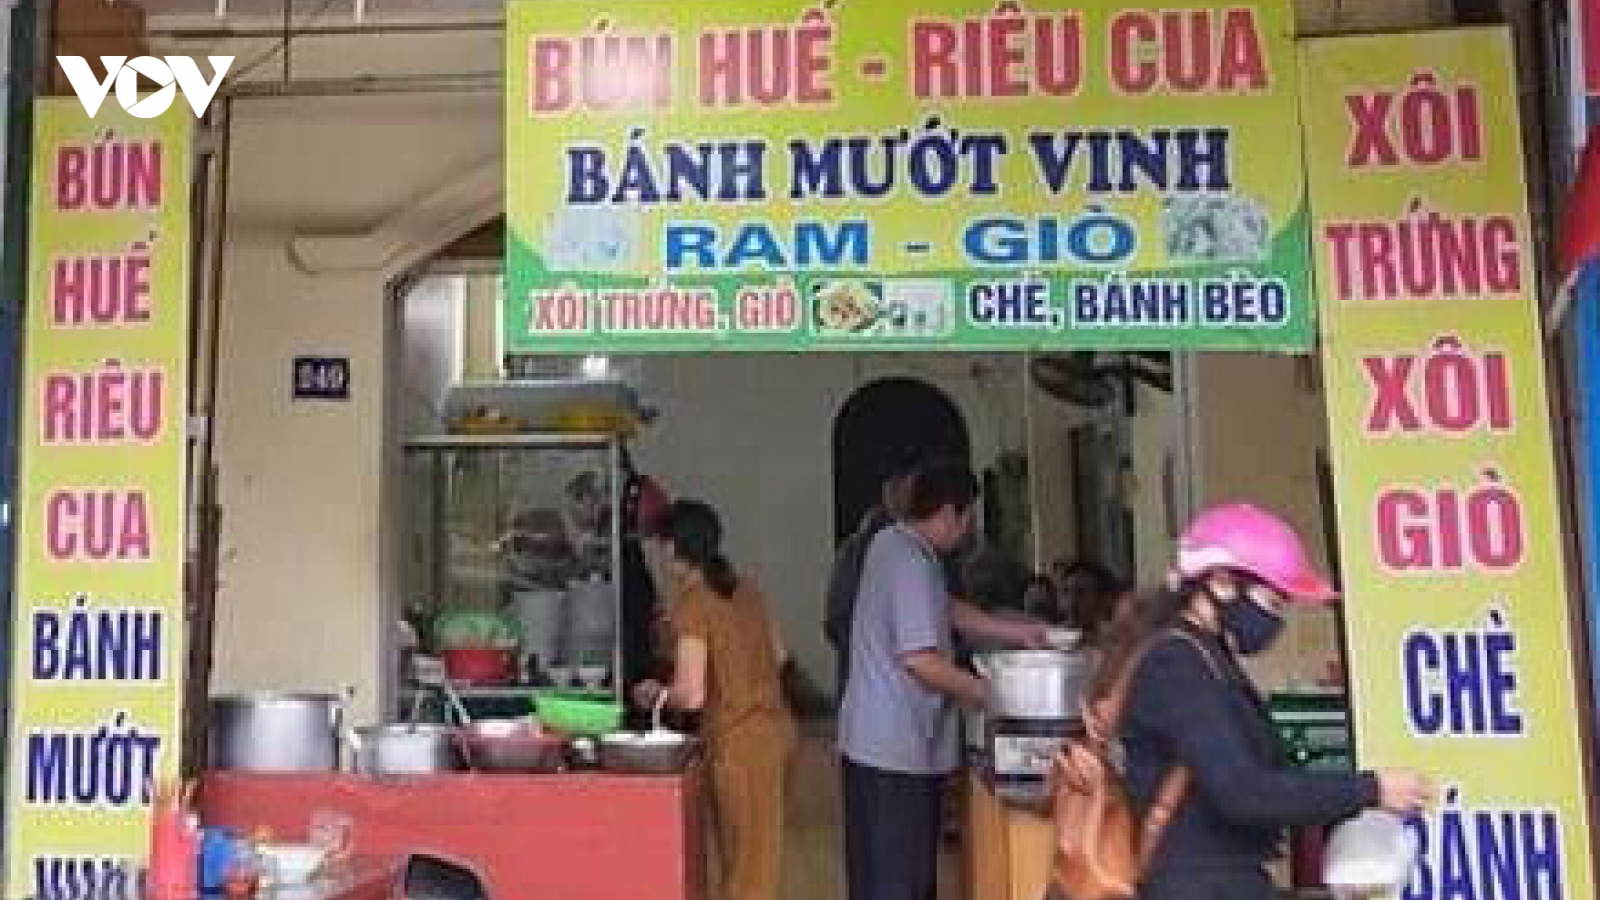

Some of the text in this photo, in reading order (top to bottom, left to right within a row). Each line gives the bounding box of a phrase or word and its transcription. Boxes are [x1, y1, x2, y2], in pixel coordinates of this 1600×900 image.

[532, 19, 671, 111] BÚN
[699, 0, 845, 107] HUẾ
[912, 2, 1082, 97] RIÊU
[1110, 7, 1267, 93] CUA
[567, 116, 1230, 204] BÁNH MƯỚT VINH
[1345, 72, 1482, 166] XÔI
[56, 128, 162, 211] BÚN
[53, 229, 157, 323] HUẾ
[665, 220, 869, 269] RAM
[964, 203, 1136, 264] GIÒ
[1326, 197, 1521, 300] TRỨNG
[534, 282, 588, 331] XÔI
[971, 274, 1060, 327] CHÈ,
[1076, 271, 1188, 324] BÁNH
[1204, 271, 1288, 324] BÈO
[43, 358, 165, 441] RIÊU
[1361, 335, 1513, 432] XÔI
[46, 489, 151, 560] CUA
[1376, 467, 1523, 570] GIÒ
[32, 595, 161, 680] BÁNH
[1403, 608, 1523, 736] CHÈ
[28, 711, 160, 806] MƯỚT
